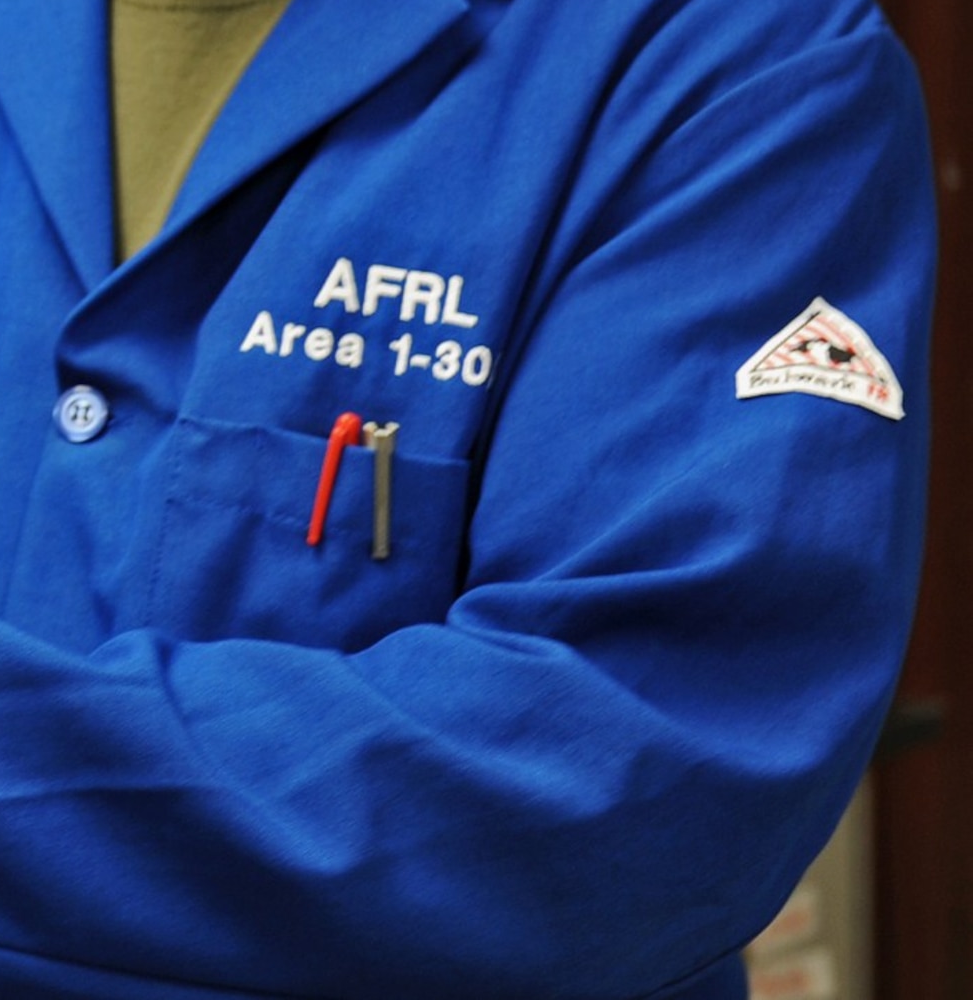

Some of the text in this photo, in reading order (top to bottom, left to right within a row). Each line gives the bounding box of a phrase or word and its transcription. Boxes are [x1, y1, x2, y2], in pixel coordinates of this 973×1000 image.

[313, 257, 479, 328] AFRL
[239, 310, 493, 386] Area 1-30
